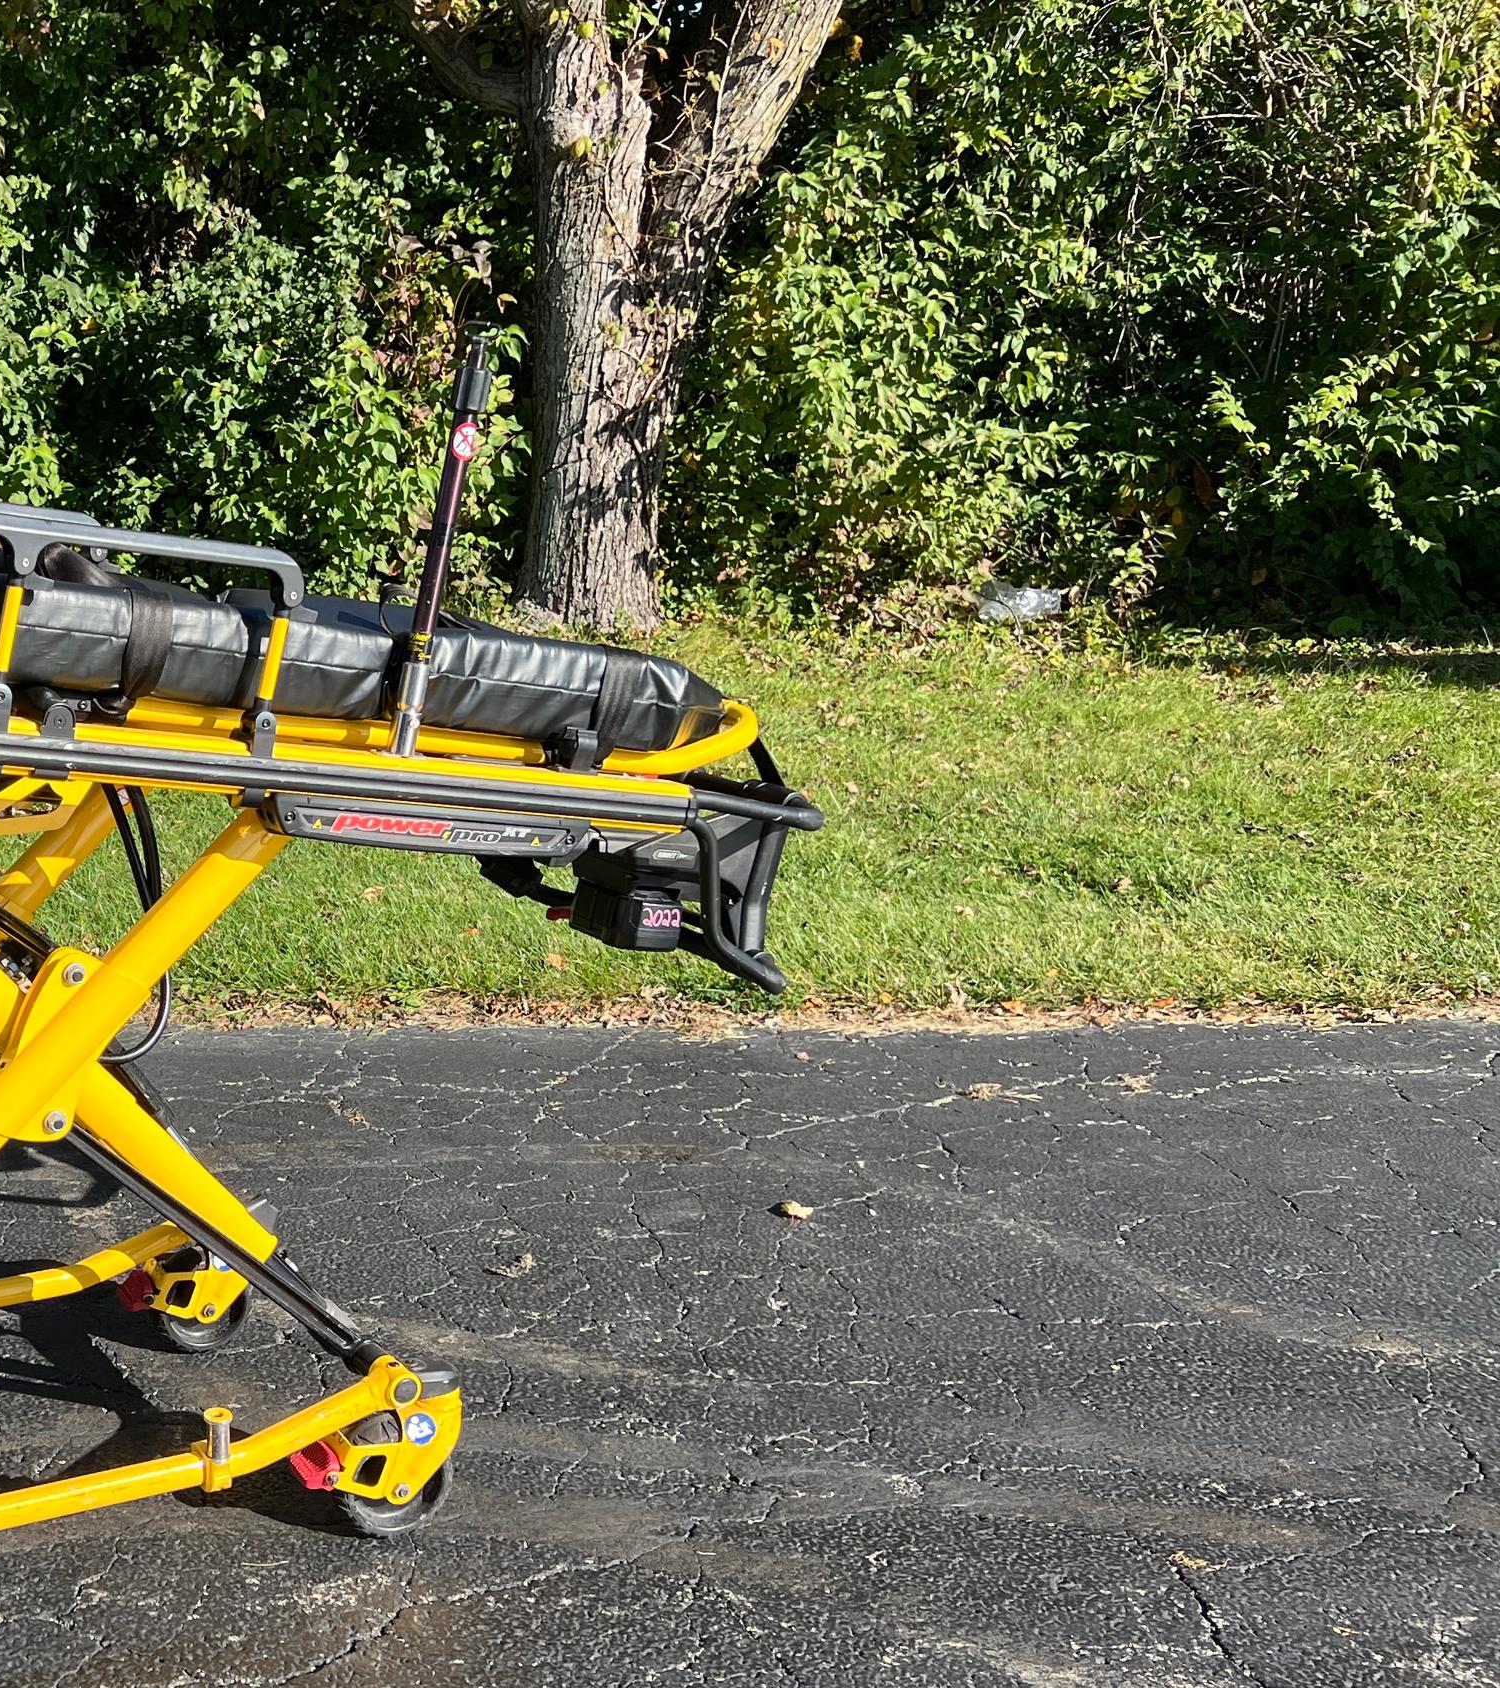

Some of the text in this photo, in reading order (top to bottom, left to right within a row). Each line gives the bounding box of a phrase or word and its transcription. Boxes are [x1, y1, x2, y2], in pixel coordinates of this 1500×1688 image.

[330, 813, 532, 845] power pro XT
[642, 907, 681, 928] 2022
